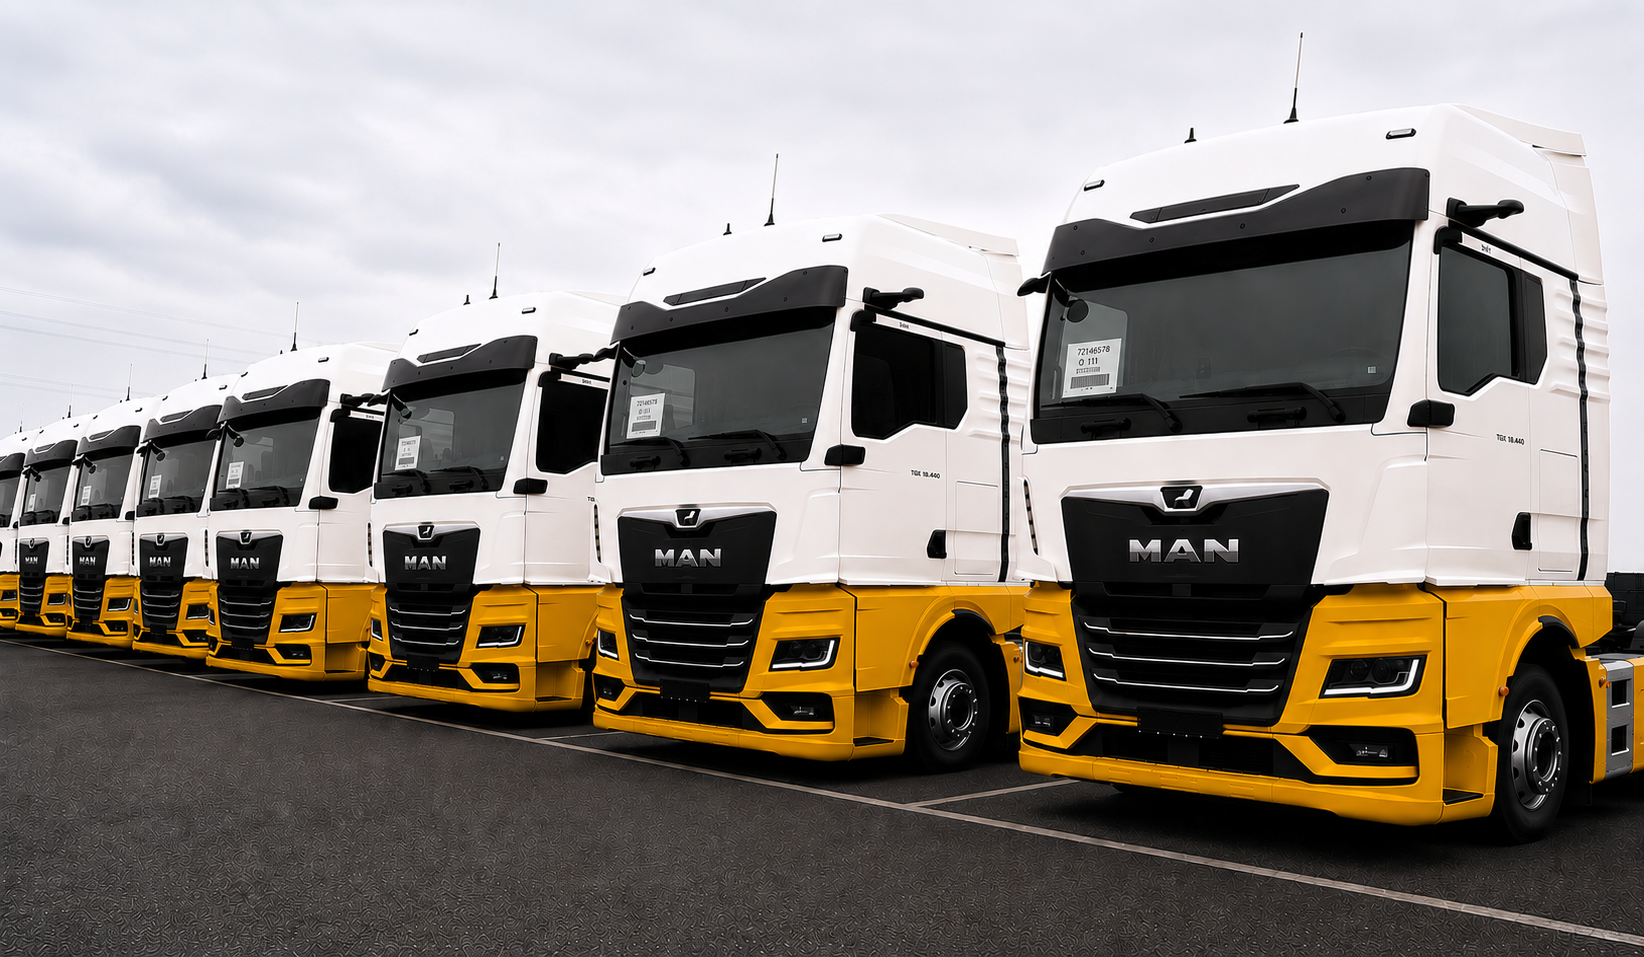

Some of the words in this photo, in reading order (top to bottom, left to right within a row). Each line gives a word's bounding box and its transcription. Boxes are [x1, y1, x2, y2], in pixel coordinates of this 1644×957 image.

[655, 548, 722, 567] MAN
[1129, 538, 1239, 563] MAN
[79, 556, 96, 566] MAN
[149, 556, 171, 567] MAN
[230, 557, 260, 570] MAN
[404, 555, 447, 571] MAN
